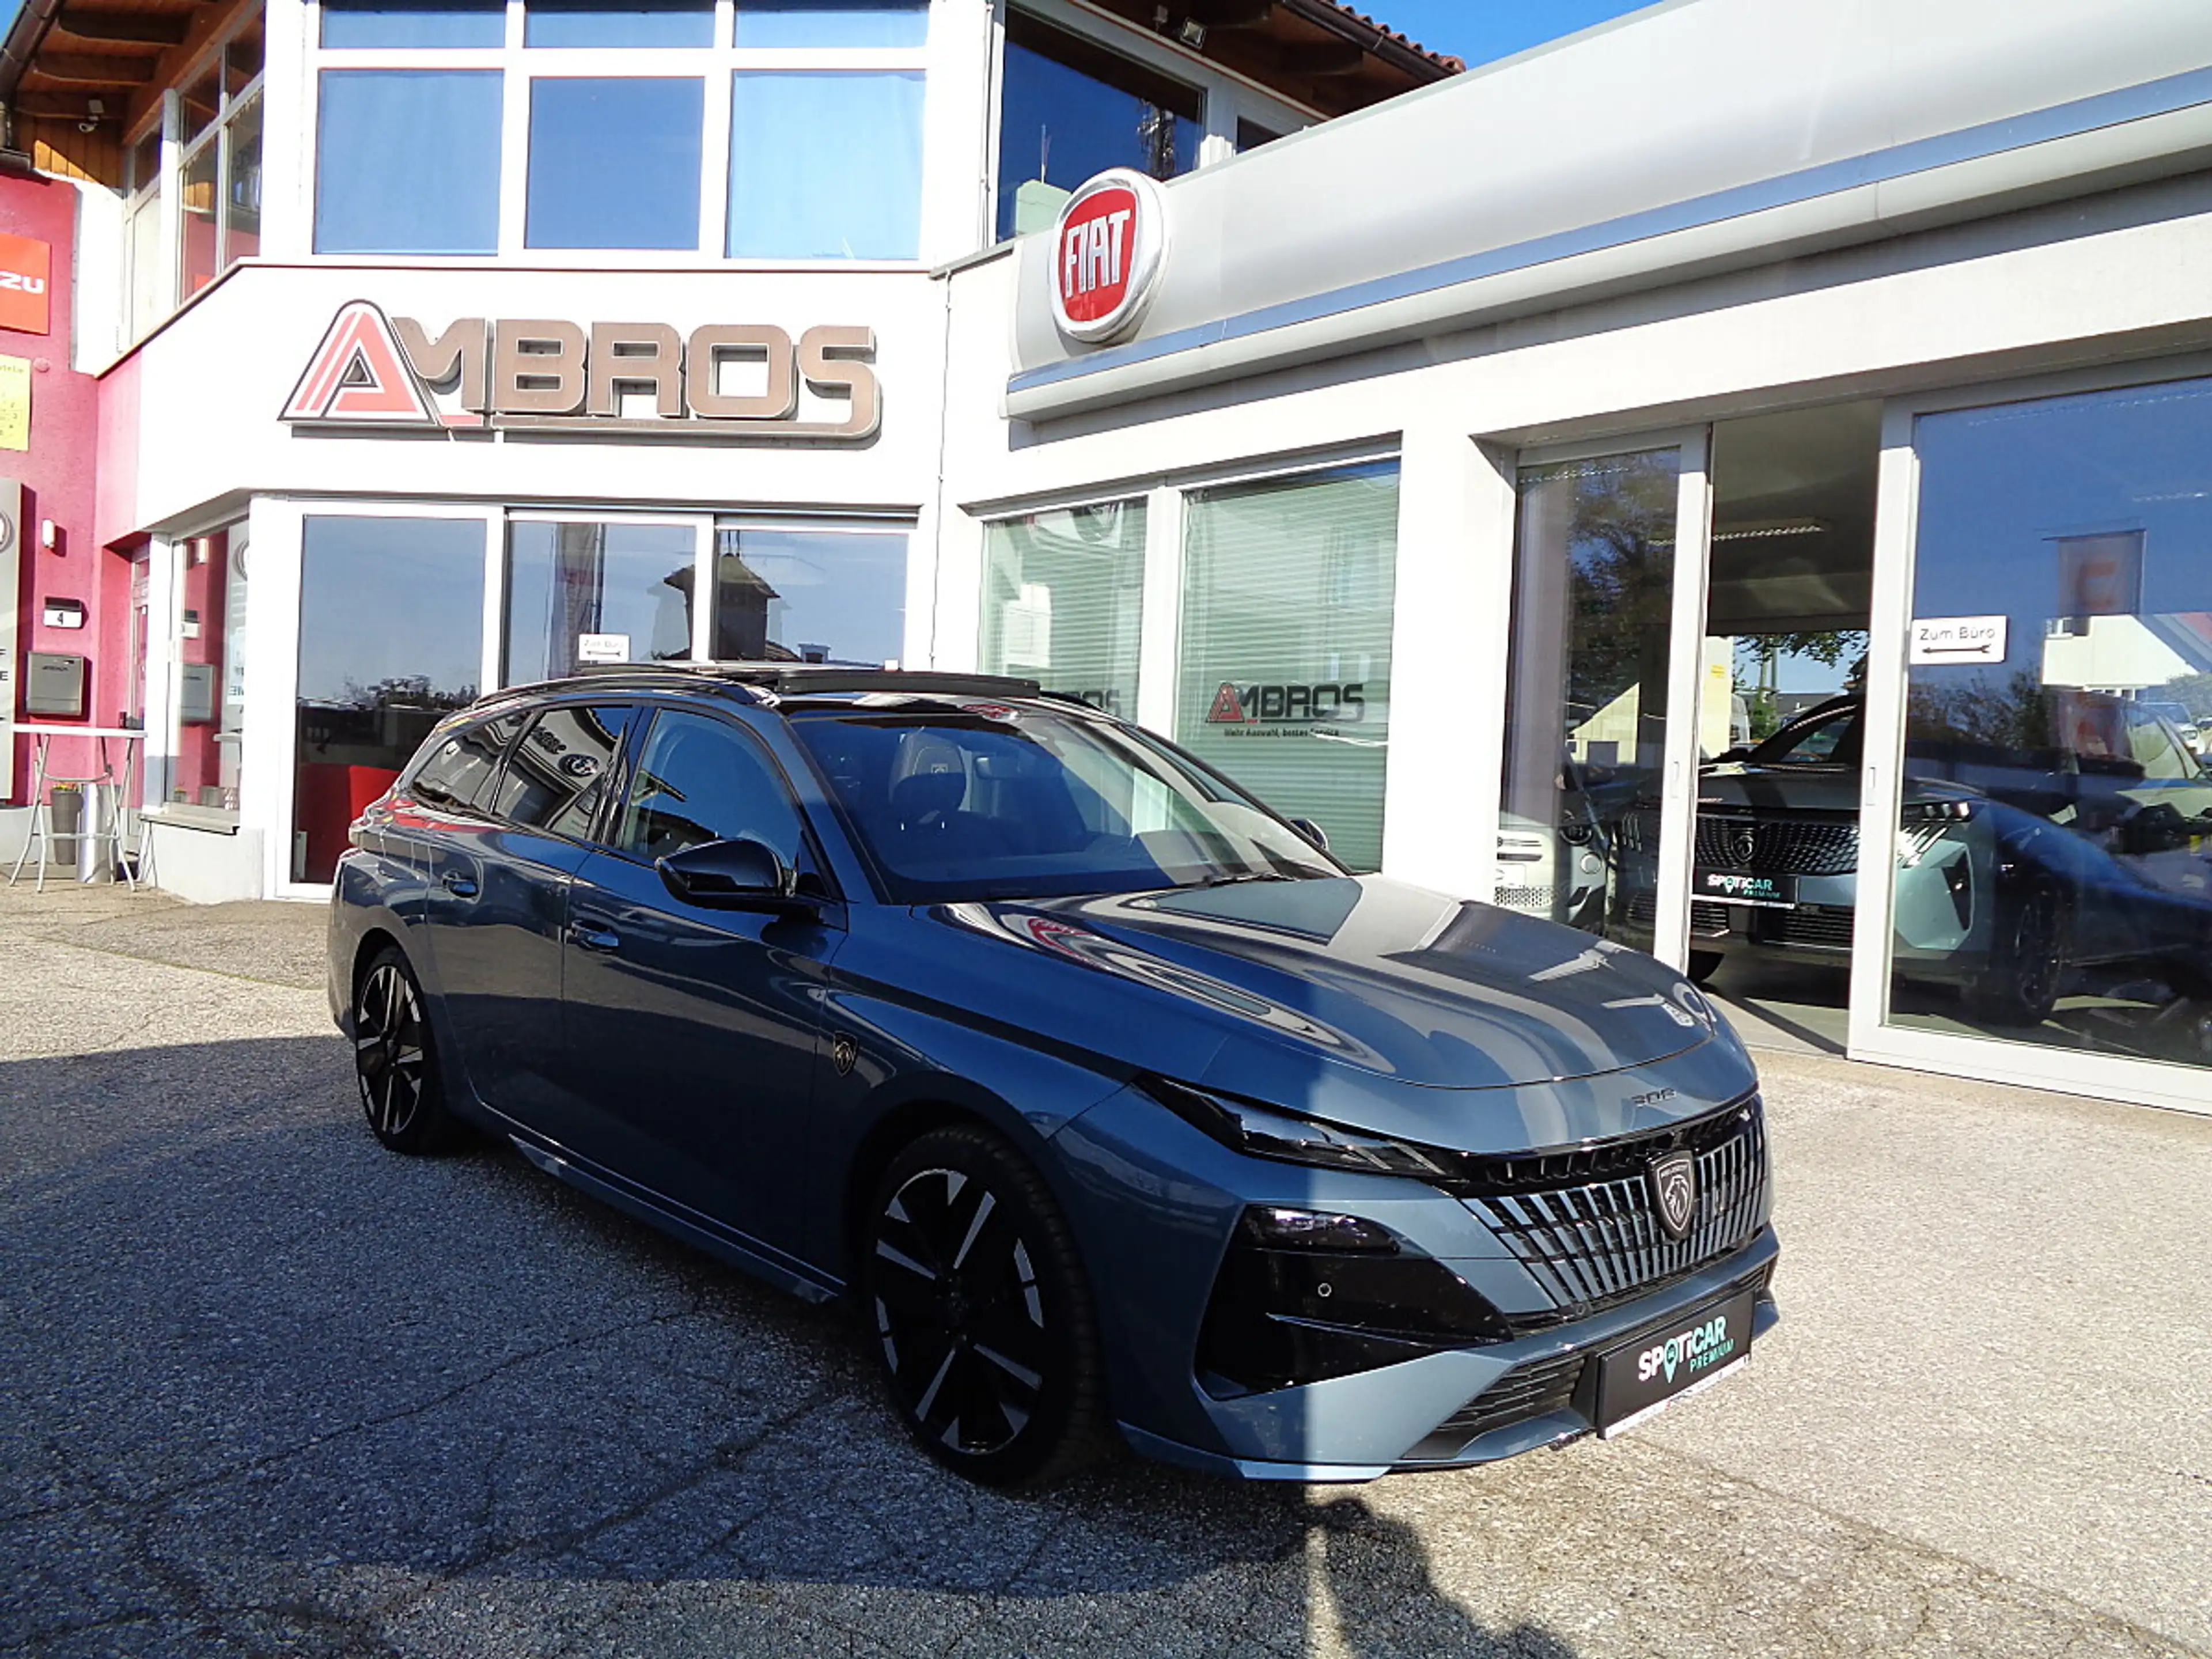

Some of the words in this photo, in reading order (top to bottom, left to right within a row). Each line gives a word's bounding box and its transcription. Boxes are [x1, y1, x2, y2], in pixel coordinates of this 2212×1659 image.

[1065, 209, 1130, 298] FIAT
[278, 298, 879, 442] AMBROS
[1919, 628, 1953, 641] Zum
[1959, 627, 1995, 639] Büro
[1205, 682, 1365, 724] AMBROS
[1690, 1339, 1734, 1372] PREMIUM
